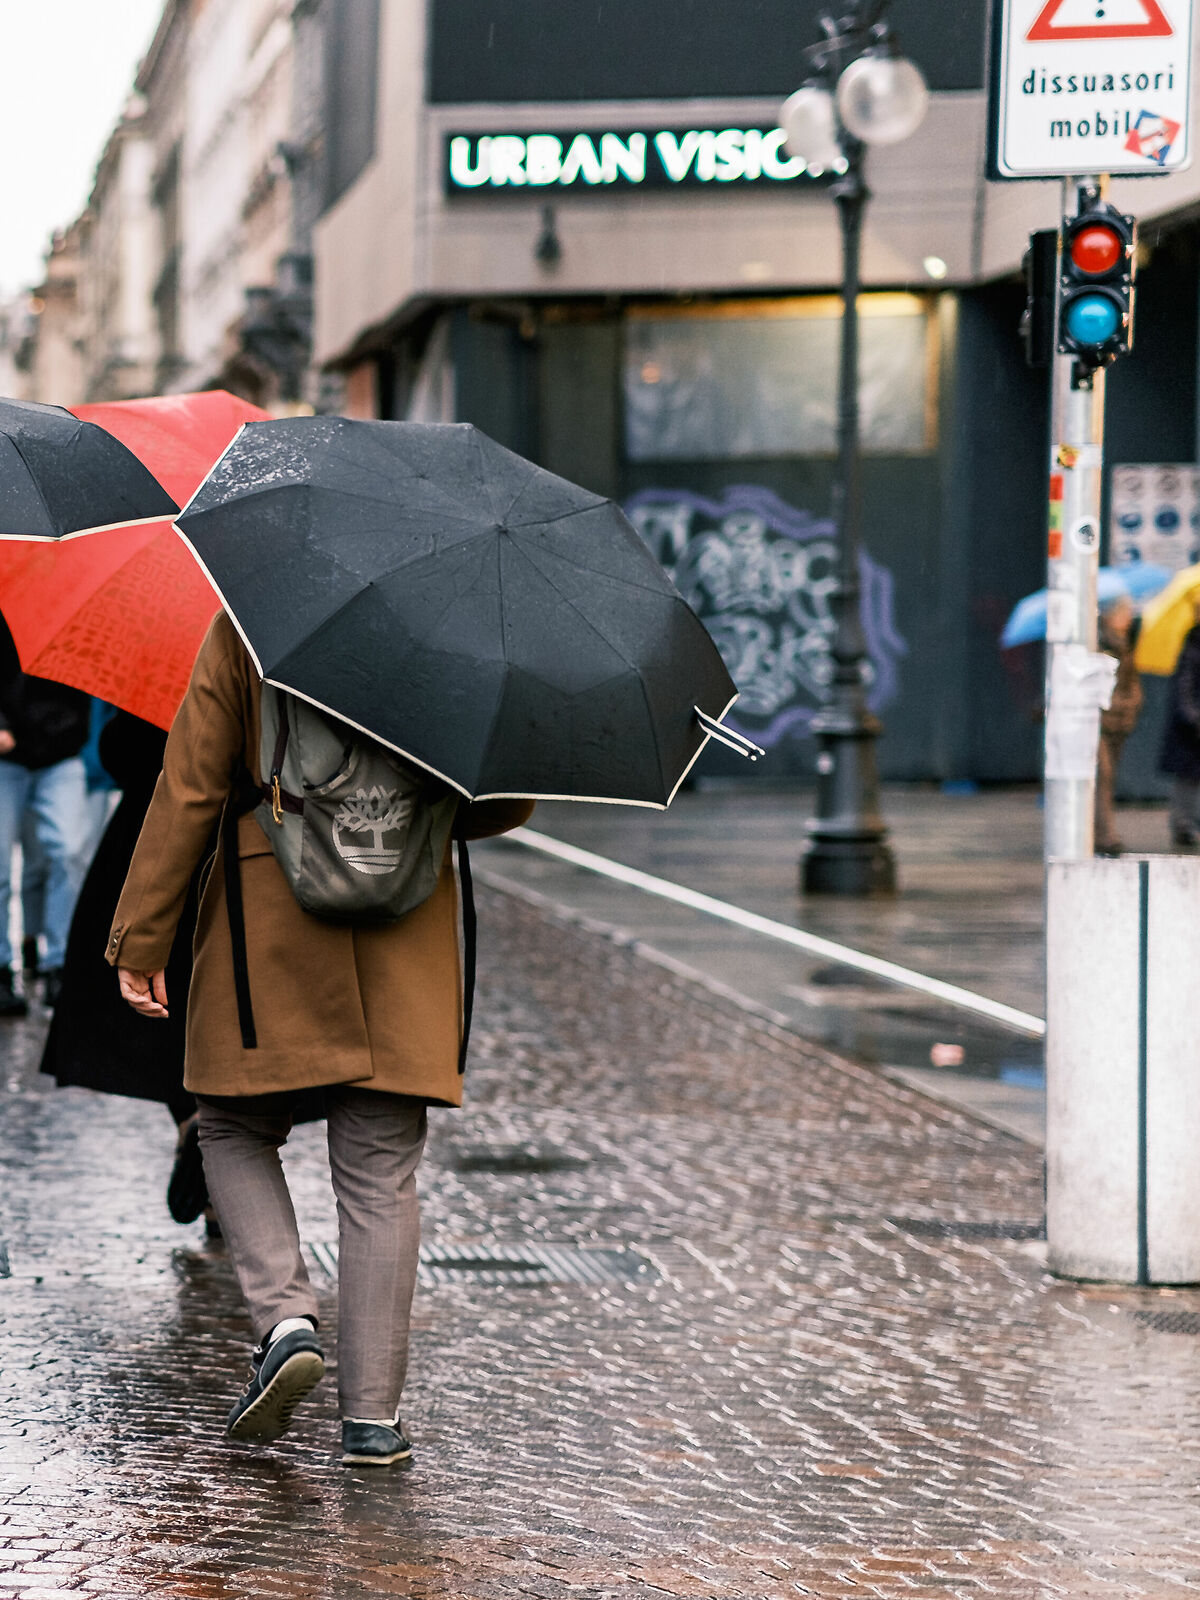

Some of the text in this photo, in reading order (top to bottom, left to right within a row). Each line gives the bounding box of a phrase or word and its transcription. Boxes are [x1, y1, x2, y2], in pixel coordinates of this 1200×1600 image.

[1022, 64, 1174, 95] dissuasori
[1050, 110, 1131, 138] mobil
[450, 128, 849, 188] URBAN VISIO
